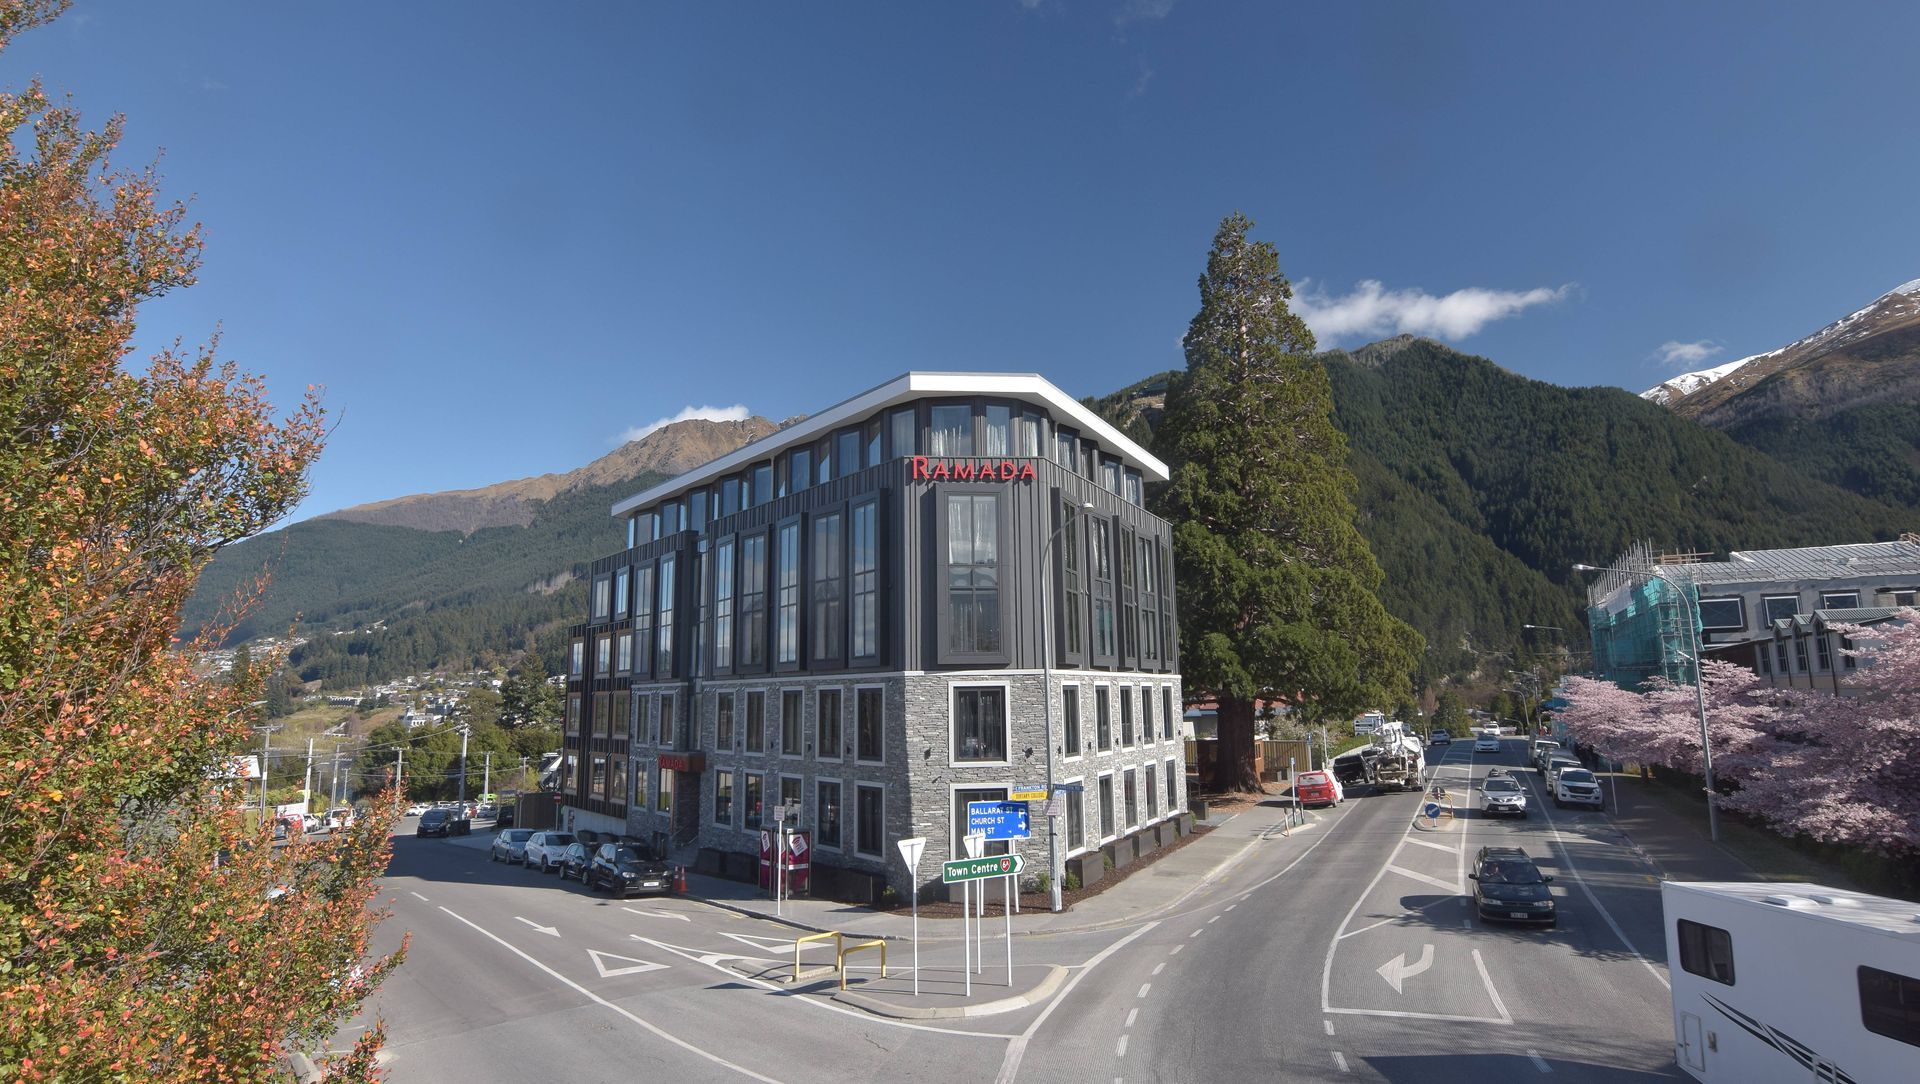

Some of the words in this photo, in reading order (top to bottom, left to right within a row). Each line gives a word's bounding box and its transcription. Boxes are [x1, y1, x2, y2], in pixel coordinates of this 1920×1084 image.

[912, 456, 1037, 481] RAMADA
[971, 806, 1004, 815] BALLARAT
[1005, 806, 1013, 814] ST
[971, 817, 996, 825] CHURCH
[997, 816, 1005, 824] ST
[971, 827, 985, 835] MAN
[947, 867, 968, 877] Town
[971, 863, 998, 874] Centre
